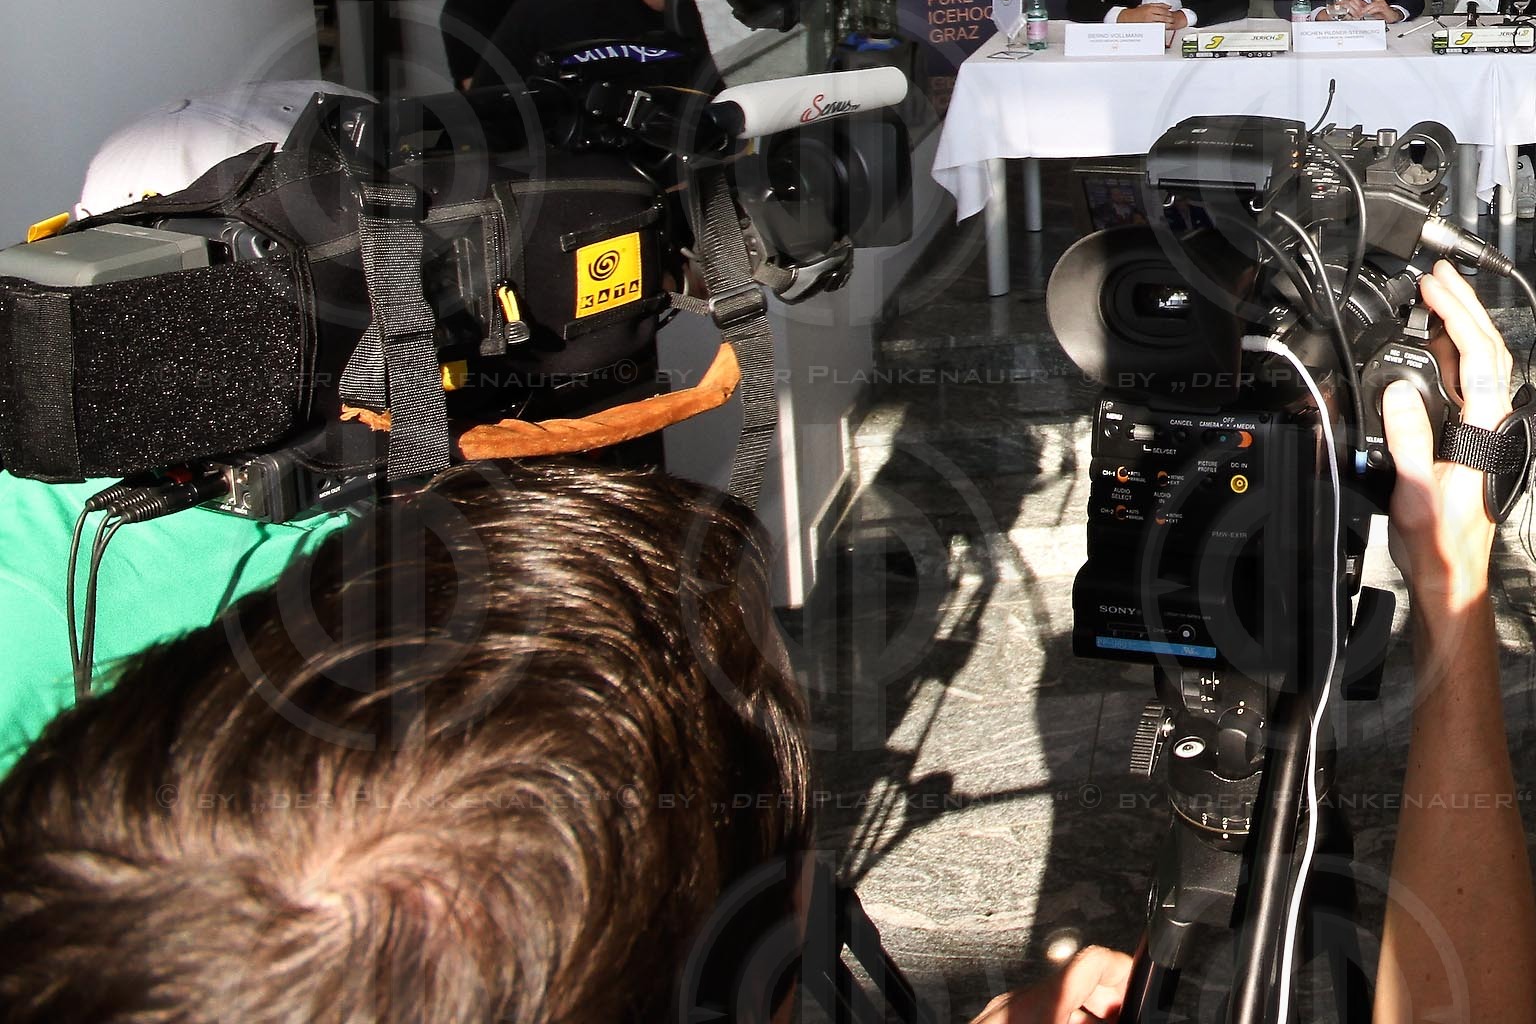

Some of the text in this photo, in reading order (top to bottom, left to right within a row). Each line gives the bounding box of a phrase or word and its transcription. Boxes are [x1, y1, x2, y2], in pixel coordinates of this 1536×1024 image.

[929, 26, 979, 44] GRAZ
[580, 280, 640, 310] KATA
[1170, 419, 1193, 427] CANCEL
[1099, 605, 1137, 615] SONY
[1202, 813, 1207, 821] 3
